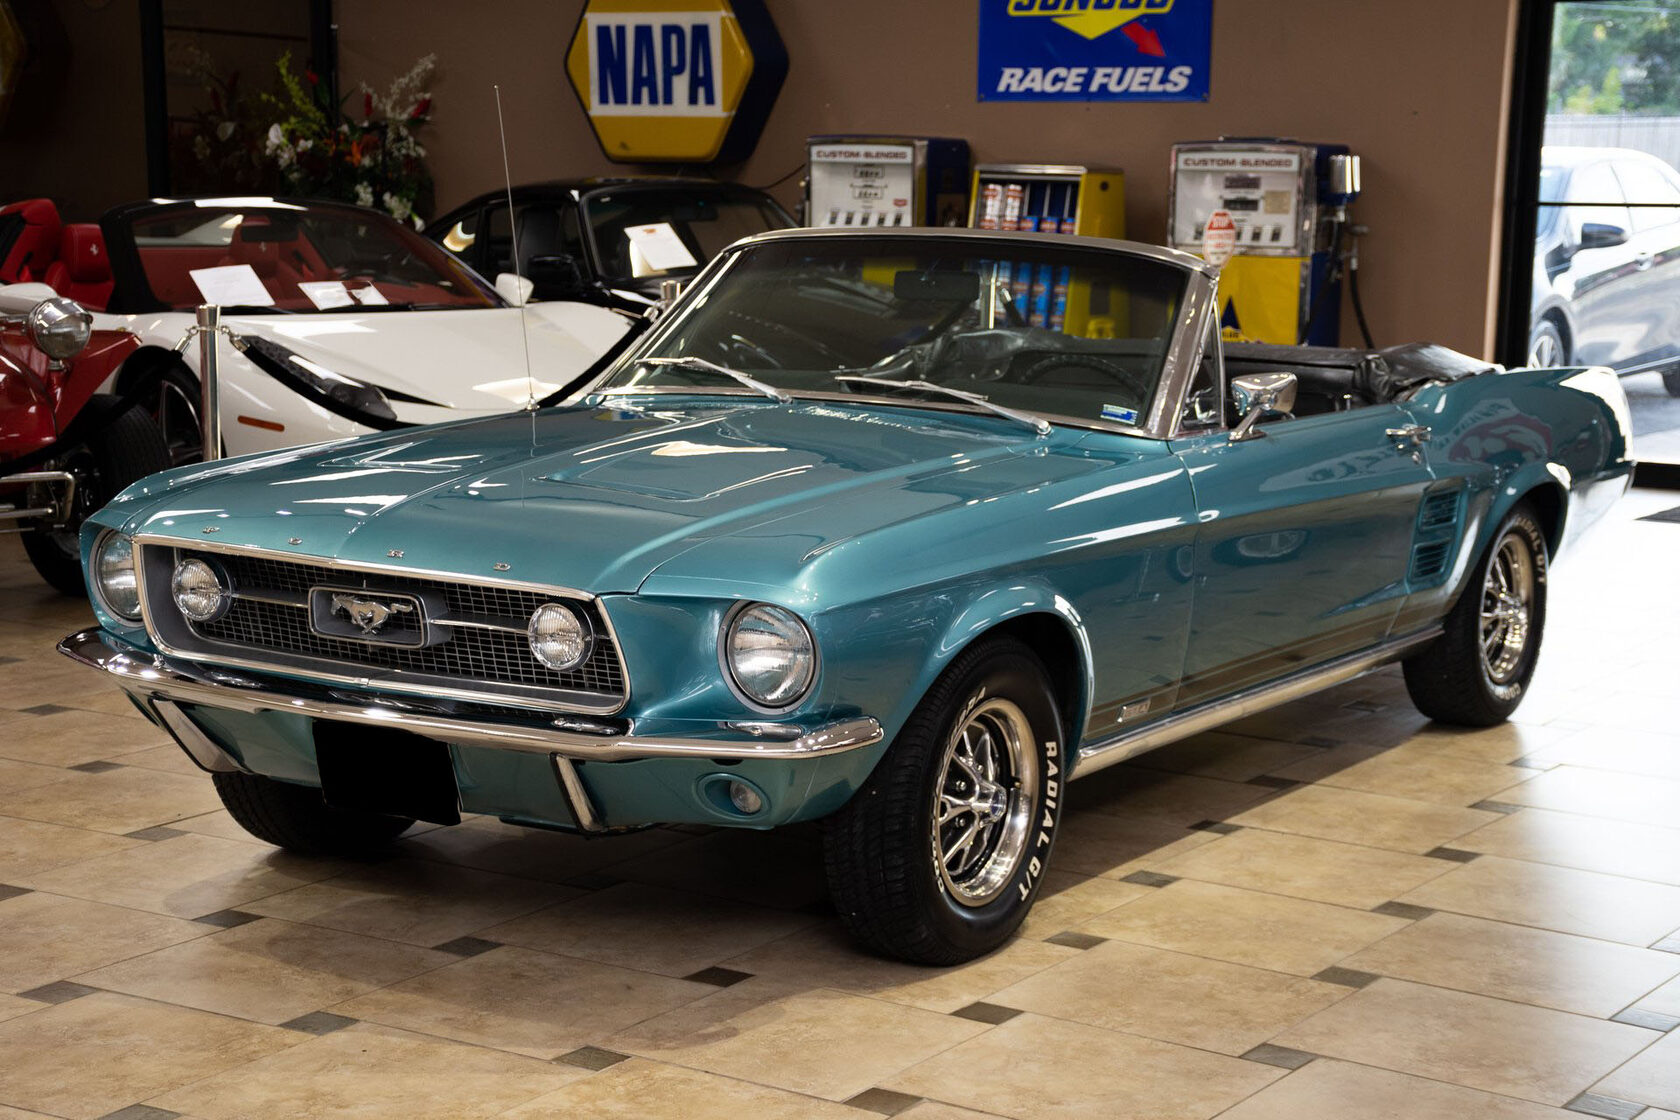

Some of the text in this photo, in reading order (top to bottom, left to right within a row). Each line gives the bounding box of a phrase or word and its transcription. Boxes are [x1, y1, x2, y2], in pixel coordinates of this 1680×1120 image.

[596, 24, 715, 105] NAPA
[996, 66, 1193, 93] RACE FUELS
[816, 150, 860, 158] CUSTOM
[1183, 158, 1293, 167] CUSTOM BLENDED
[1018, 741, 1059, 901] RADIAL G/T
